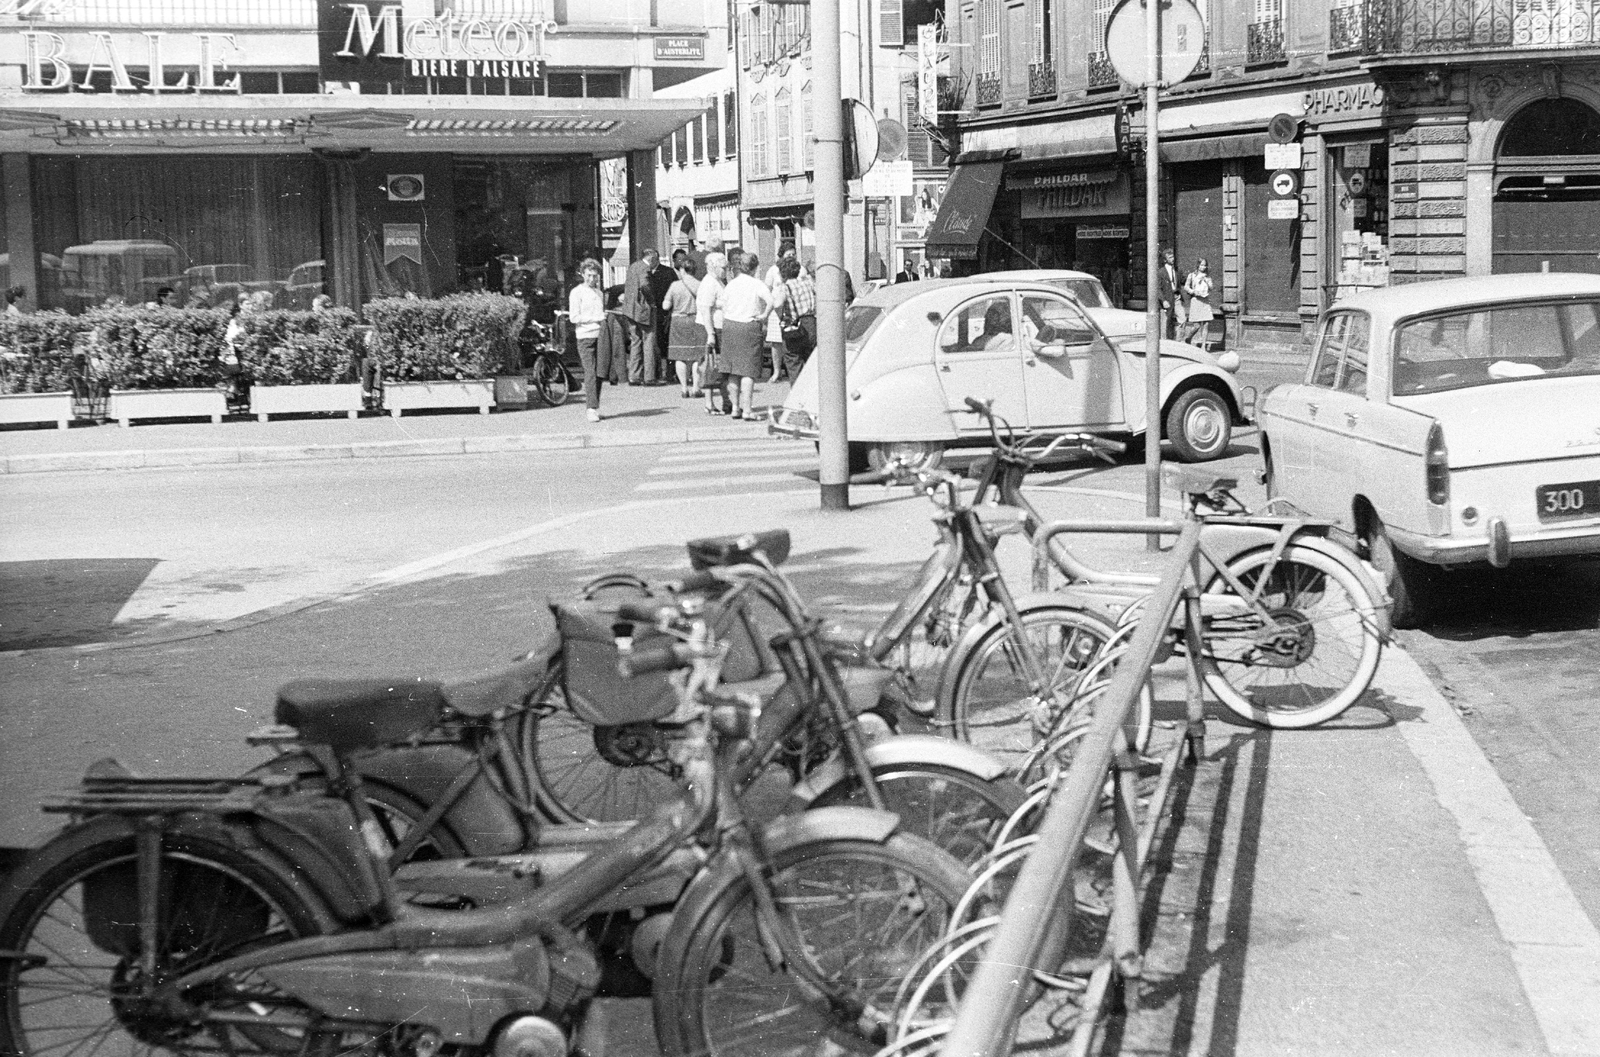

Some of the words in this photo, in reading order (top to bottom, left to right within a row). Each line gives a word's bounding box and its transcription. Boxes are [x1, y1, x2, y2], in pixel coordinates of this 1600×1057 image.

[333, 3, 558, 57] Meteor
[411, 59, 458, 77] BIERE
[466, 59, 540, 78] D'ALSACE
[1120, 105, 1130, 153] TABAC
[1033, 173, 1088, 185] PHILDAR
[1544, 488, 1584, 512] 300
